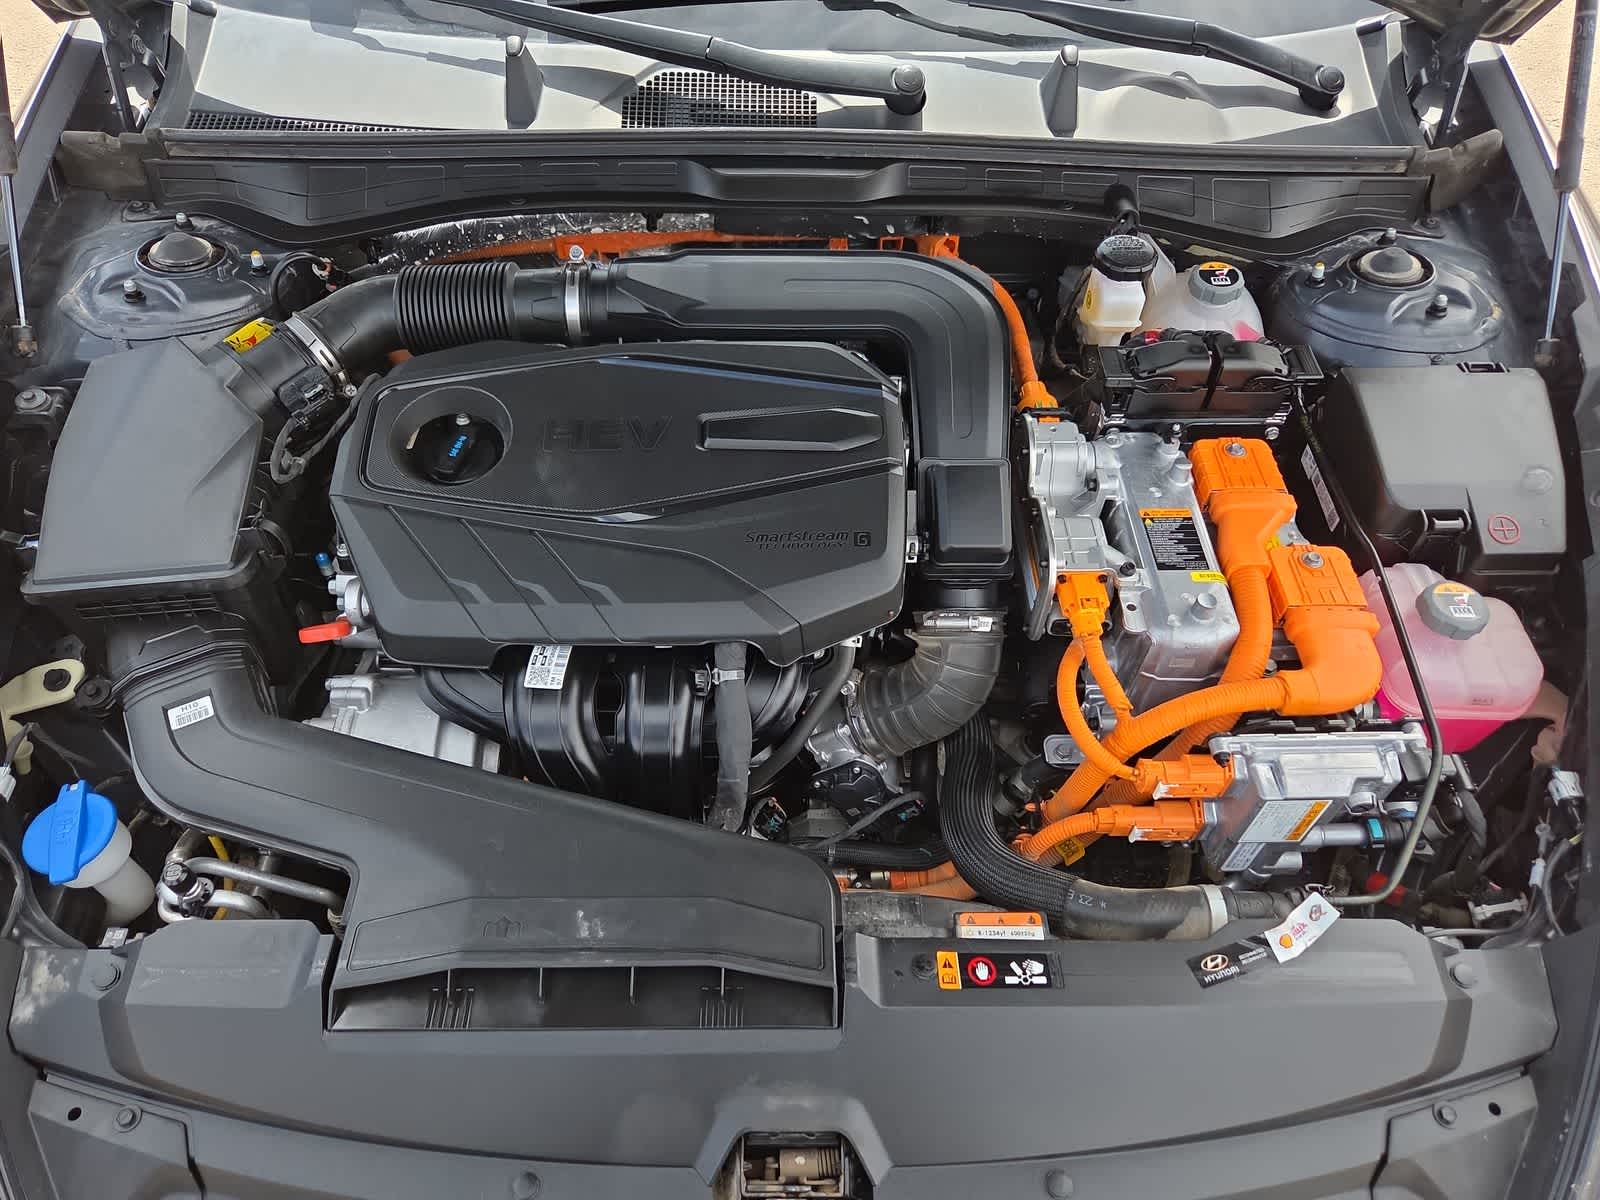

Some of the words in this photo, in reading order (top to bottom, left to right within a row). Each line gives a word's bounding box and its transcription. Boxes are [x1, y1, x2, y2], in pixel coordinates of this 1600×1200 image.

[541, 415, 673, 454] HEV
[744, 530, 848, 543] Smartstream
[1203, 965, 1240, 984] HYUNDAI
